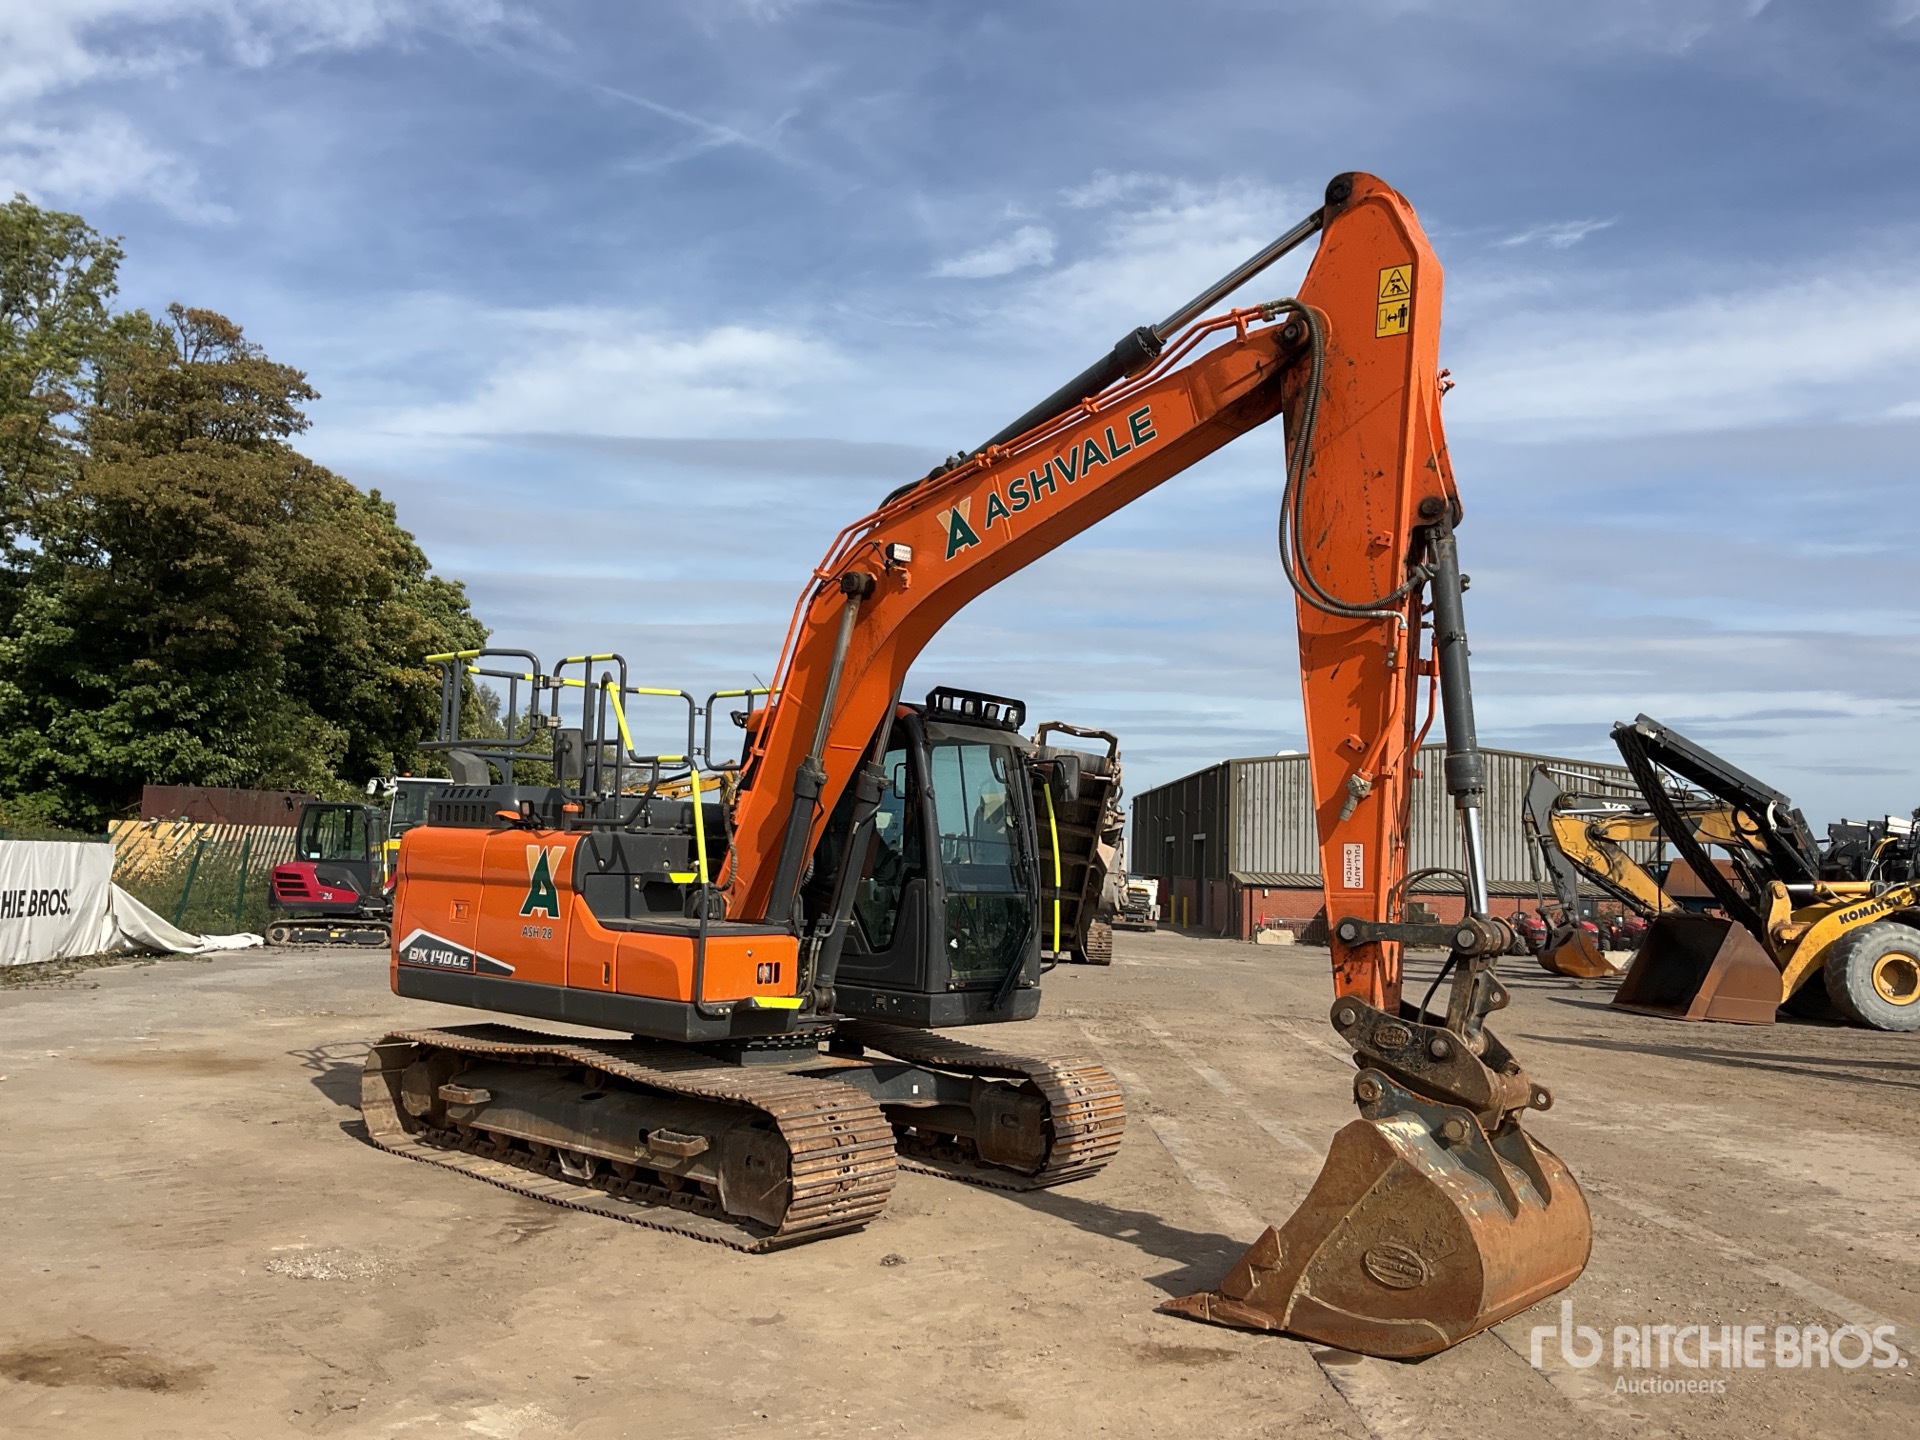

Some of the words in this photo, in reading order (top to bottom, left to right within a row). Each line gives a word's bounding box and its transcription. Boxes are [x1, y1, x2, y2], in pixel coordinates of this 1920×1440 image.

[985, 405, 1157, 529] ASHVALE
[0, 889, 27, 919] HIE
[27, 888, 71, 916] BROS.
[1838, 896, 1903, 924] KOMATSU
[521, 925, 539, 938] ASH
[541, 927, 553, 939] 28
[408, 946, 429, 963] DX
